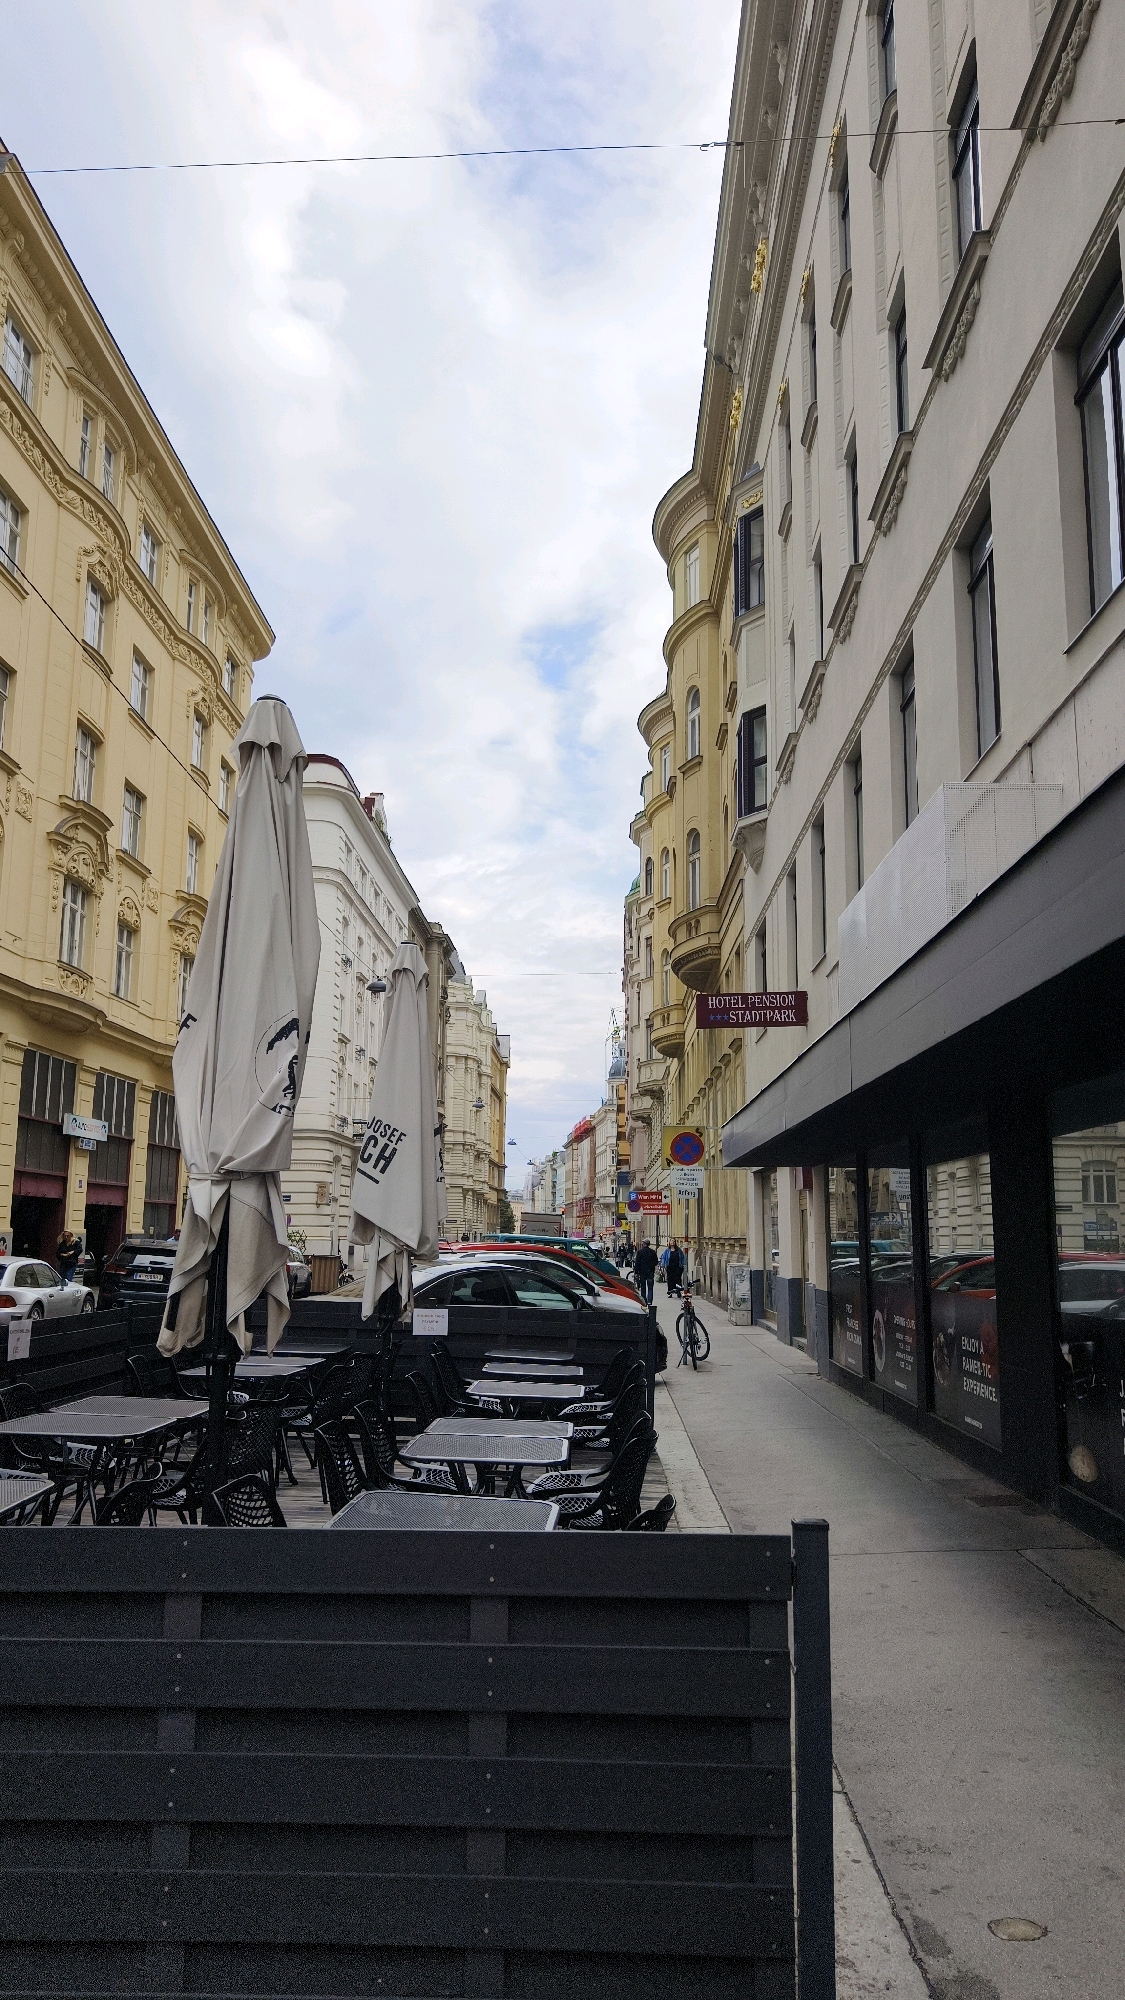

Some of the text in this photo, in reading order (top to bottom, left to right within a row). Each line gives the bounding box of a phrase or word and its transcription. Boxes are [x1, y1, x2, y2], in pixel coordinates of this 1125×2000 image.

[708, 994, 795, 1009] HOTEL PENSION
[729, 1009, 797, 1023] STADTPARK
[367, 1116, 407, 1146] JOSEF
[961, 1336, 985, 1355] ENJOY A
